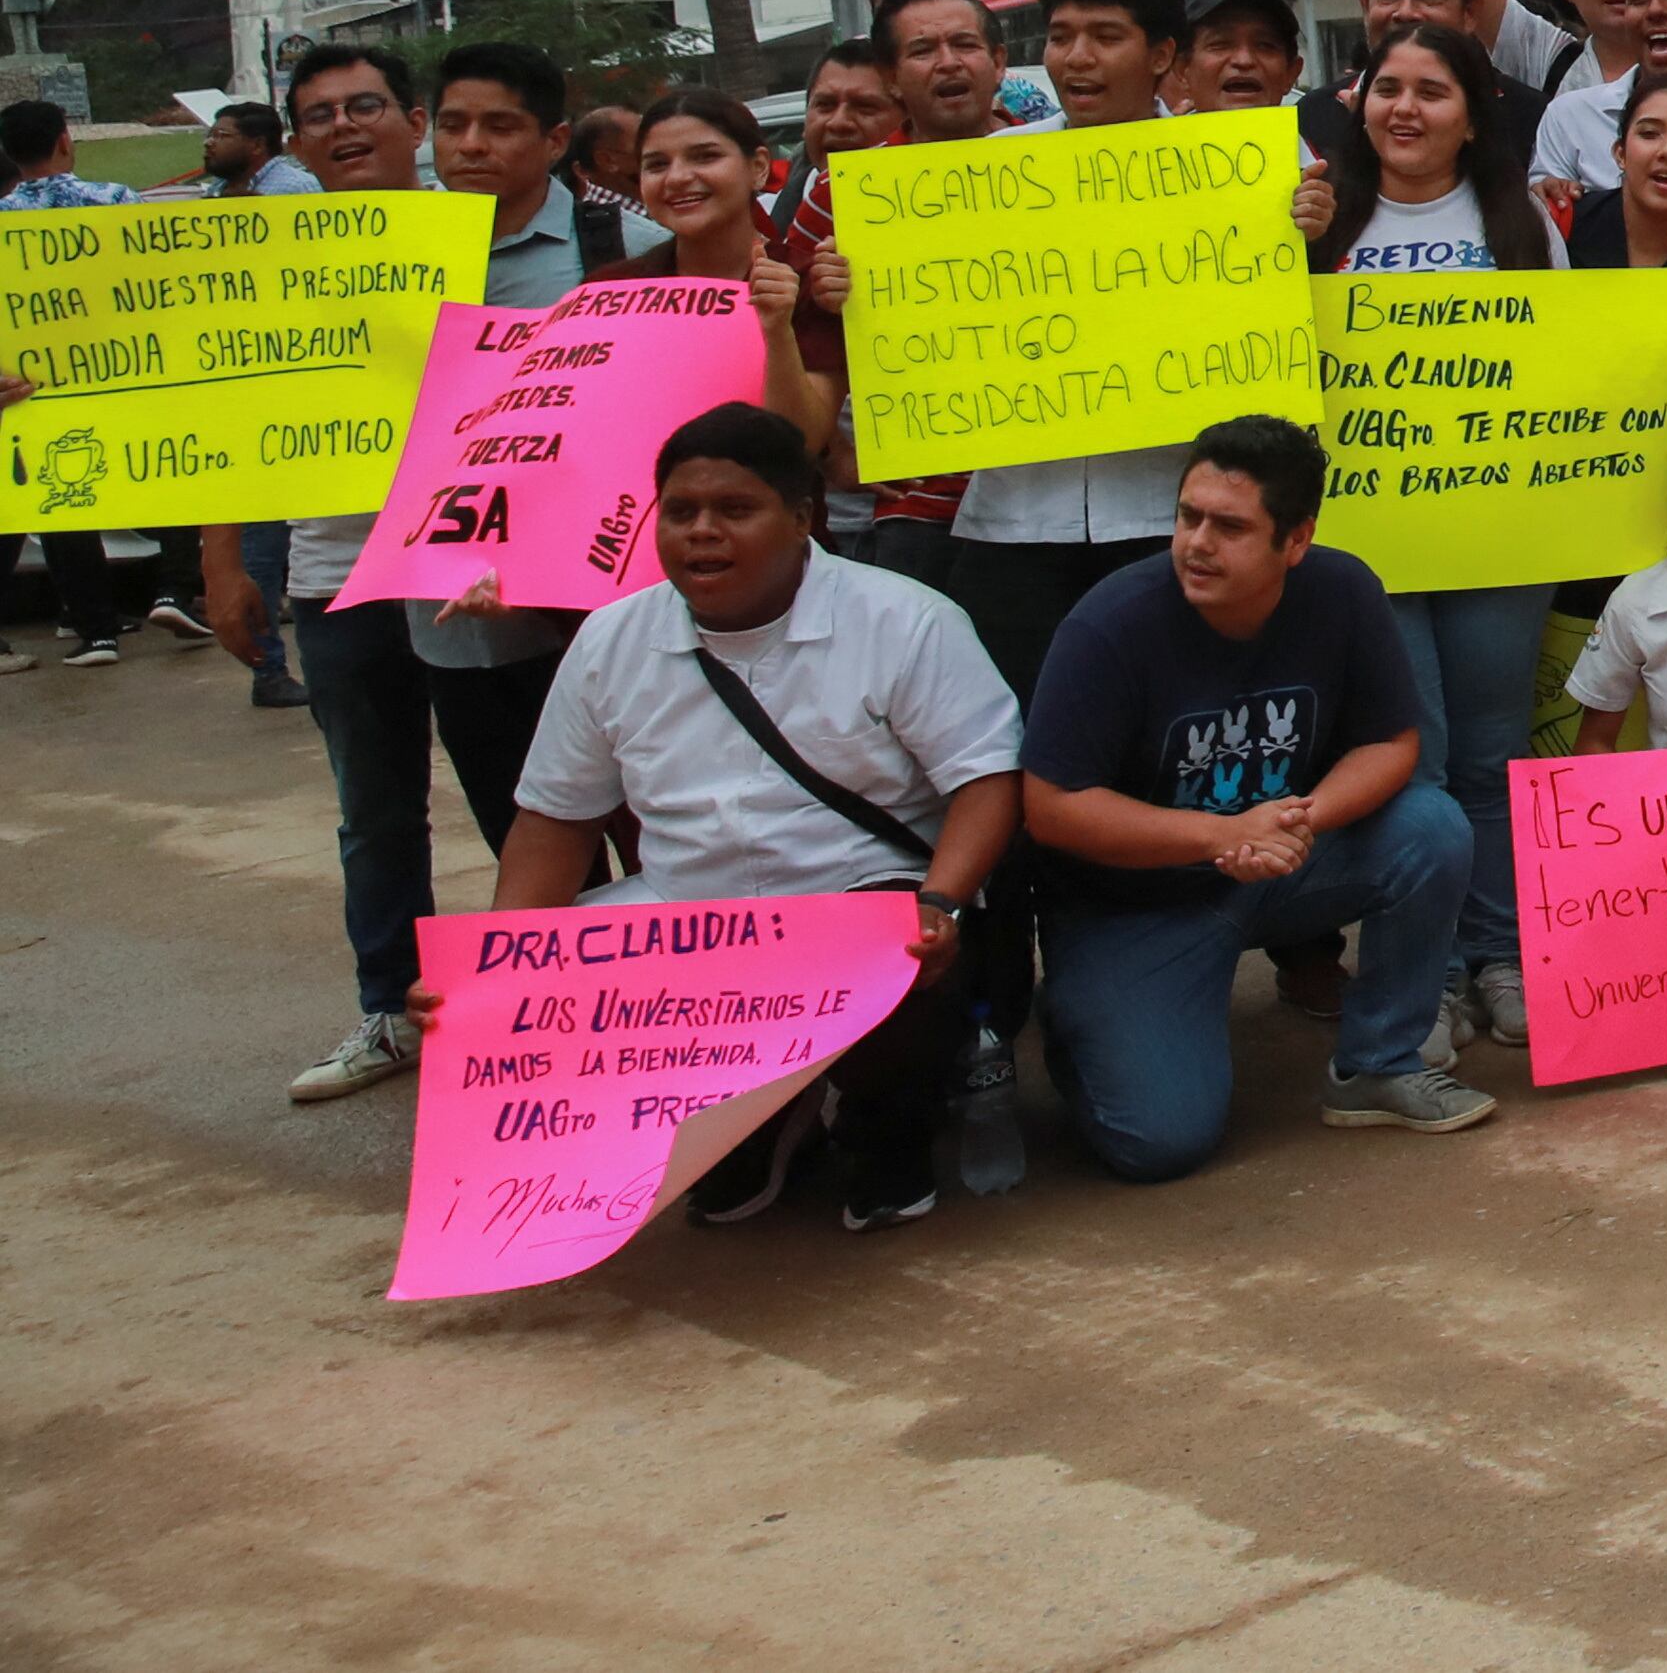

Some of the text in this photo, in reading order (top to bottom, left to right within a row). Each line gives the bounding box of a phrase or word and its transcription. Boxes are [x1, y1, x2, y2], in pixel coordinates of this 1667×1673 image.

[1075, 142, 1266, 204] HACIENDO
[6, 205, 386, 270] TODO NUESTRO APOYO
[870, 226, 1294, 308] HISTORIA LA UAGro
[6, 263, 446, 328] PARA NUESTRA PRESIDENTA
[1346, 283, 1535, 333] BIENVENIDA
[19, 319, 370, 389] CLAUDIA SHEINBAUM
[475, 320, 540, 352] LOS
[874, 314, 1077, 374] CONTIGO
[1319, 349, 1513, 392] DRA. CLAUDIA
[866, 364, 1131, 449] PRESIDENTA
[1456, 411, 1492, 444] TE
[1503, 410, 1607, 448] RECIBE
[1620, 403, 1667, 432] CON
[261, 418, 393, 467] CONTIGO
[457, 433, 561, 467] FUERZA
[1326, 451, 1645, 499] LOS BRAZOS ABIERTOS
[587, 494, 636, 574] UAGro
[476, 928, 569, 972] DRA.
[512, 988, 851, 1033] LOS UNIVERSITARIOS LE
[464, 1051, 551, 1089] DAMOS
[578, 1049, 605, 1077] LA
[782, 1039, 813, 1064] LA
[495, 1098, 595, 1141] UAGro
